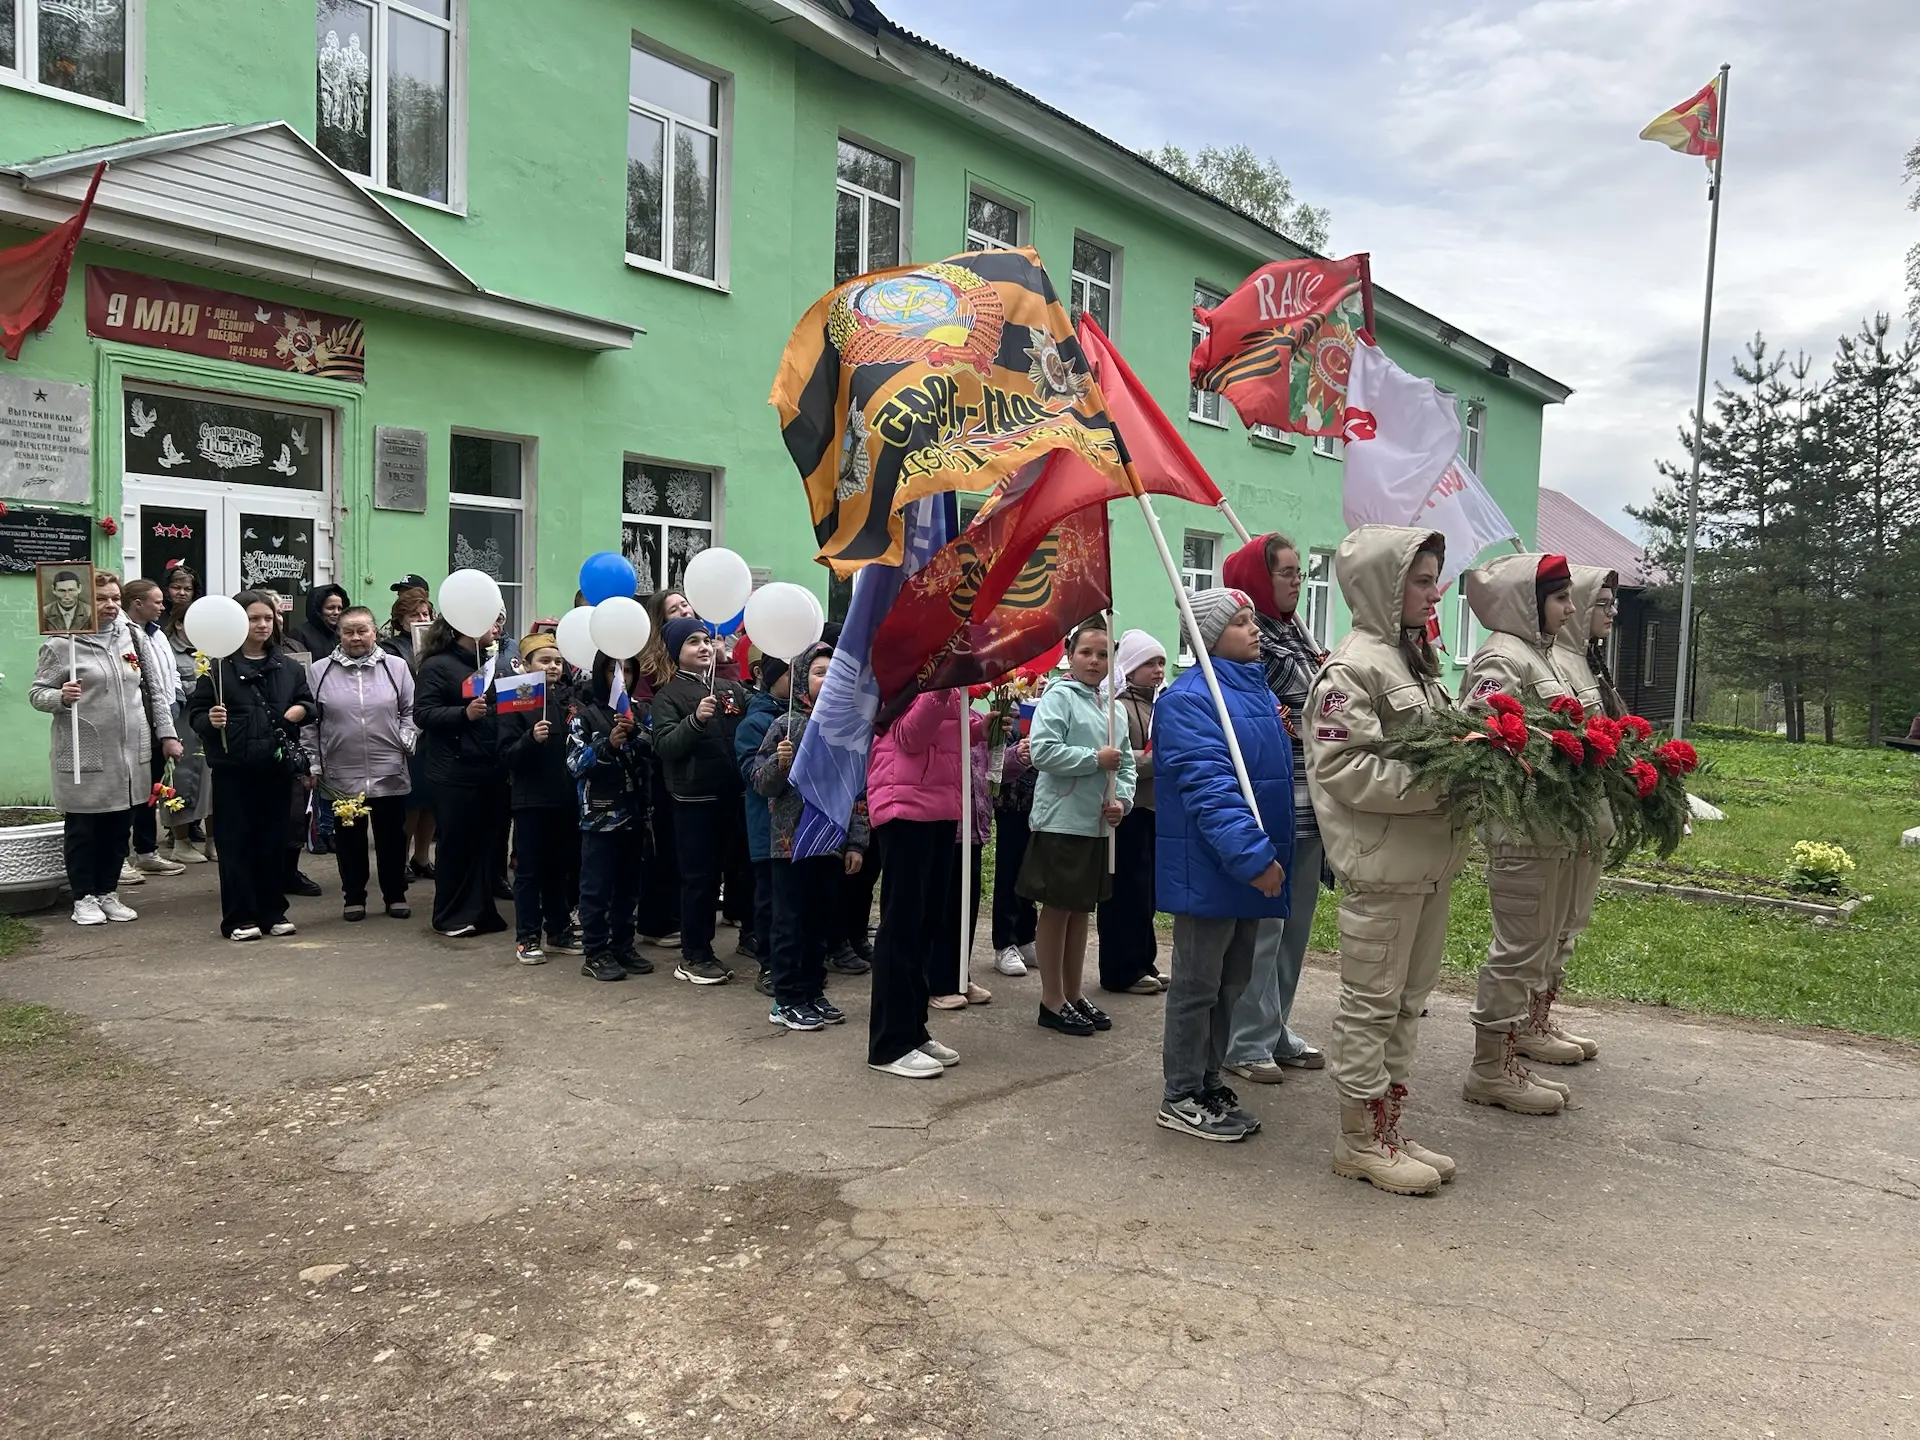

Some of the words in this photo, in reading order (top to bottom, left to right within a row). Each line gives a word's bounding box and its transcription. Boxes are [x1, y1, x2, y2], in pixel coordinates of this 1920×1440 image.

[106, 293, 127, 327] 9
[133, 297, 200, 336] МАЯ
[205, 307, 211, 318] С
[218, 319, 255, 333] ВЕЛИКОЙ
[207, 328, 244, 343] ПОБЕДЫ!
[228, 345, 268, 359] 1941-1945
[8, 406, 72, 422] ВЫПУСКНИКАМ
